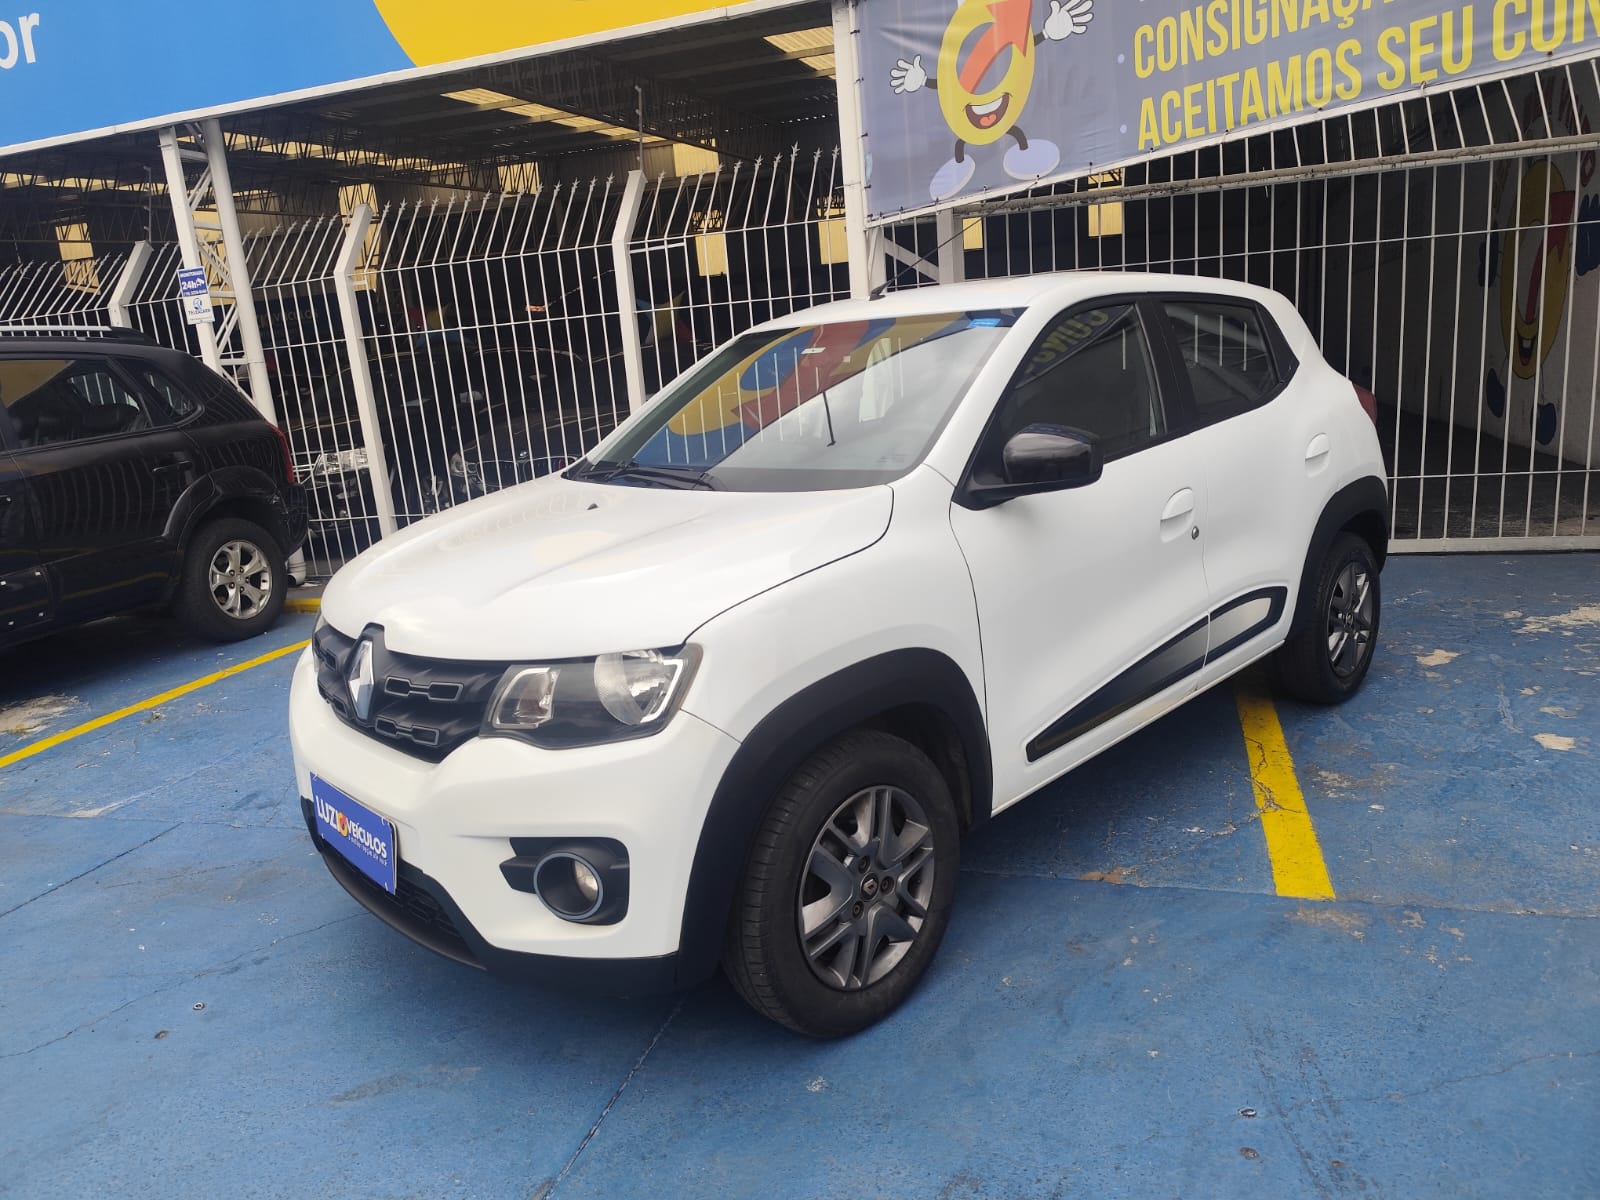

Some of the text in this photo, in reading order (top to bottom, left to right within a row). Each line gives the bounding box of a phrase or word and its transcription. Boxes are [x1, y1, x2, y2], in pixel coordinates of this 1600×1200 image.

[1138, 38, 1362, 150] ACEITAMOS
[1376, 5, 1473, 90] SEU
[346, 816, 388, 859] VEÍCULOS
